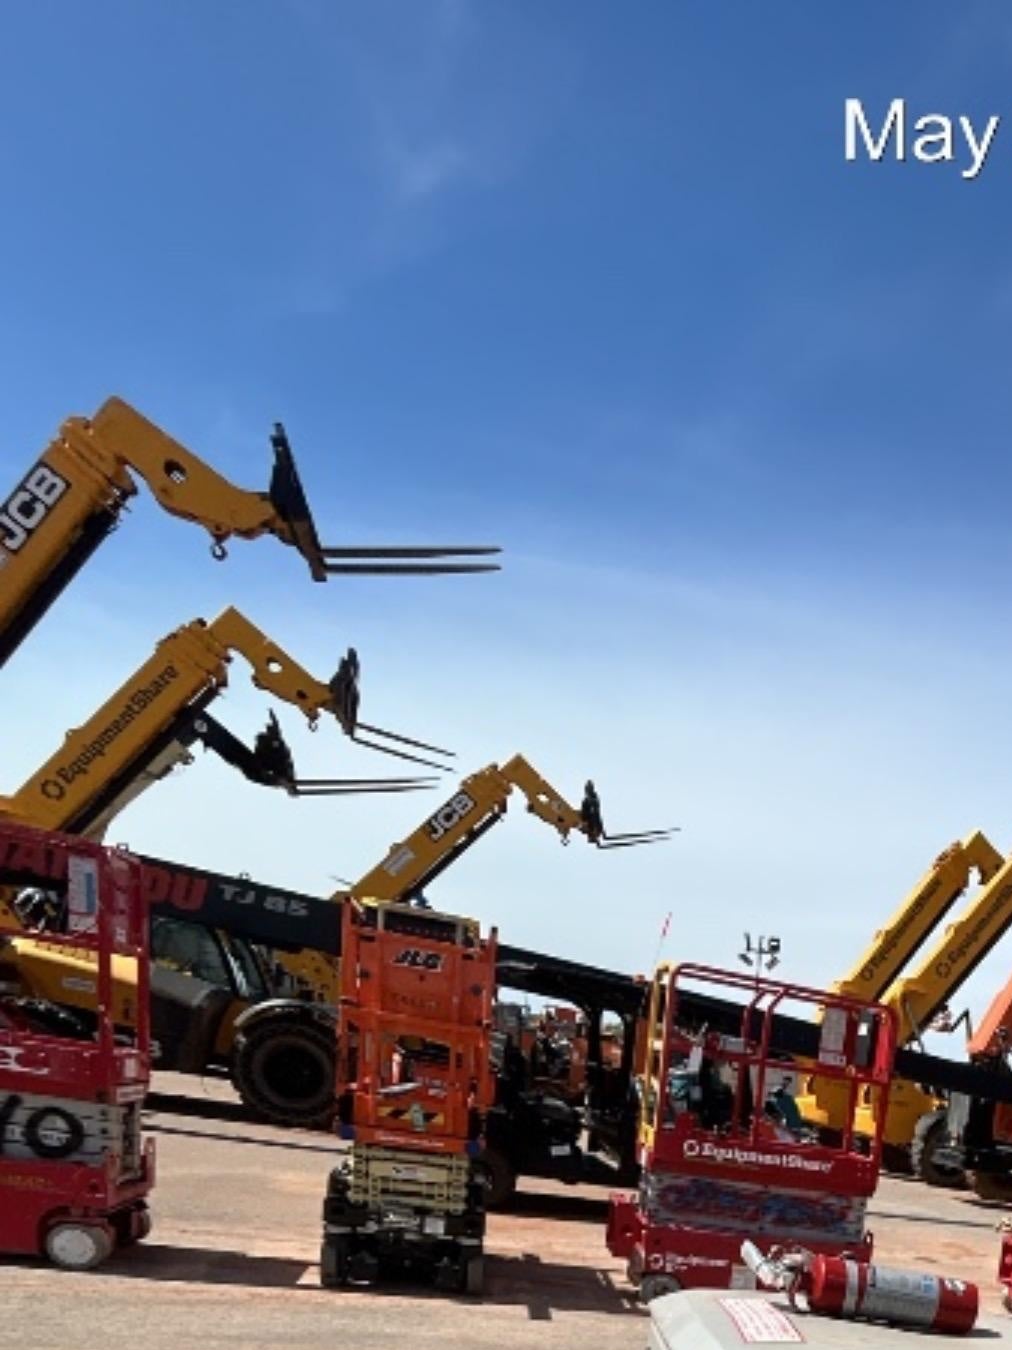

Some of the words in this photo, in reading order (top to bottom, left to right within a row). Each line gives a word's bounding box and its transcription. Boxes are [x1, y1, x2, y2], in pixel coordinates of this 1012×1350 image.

[0, 466, 67, 551] JCB
[55, 664, 178, 785] EquipmentShare
[430, 794, 475, 841] JCB
